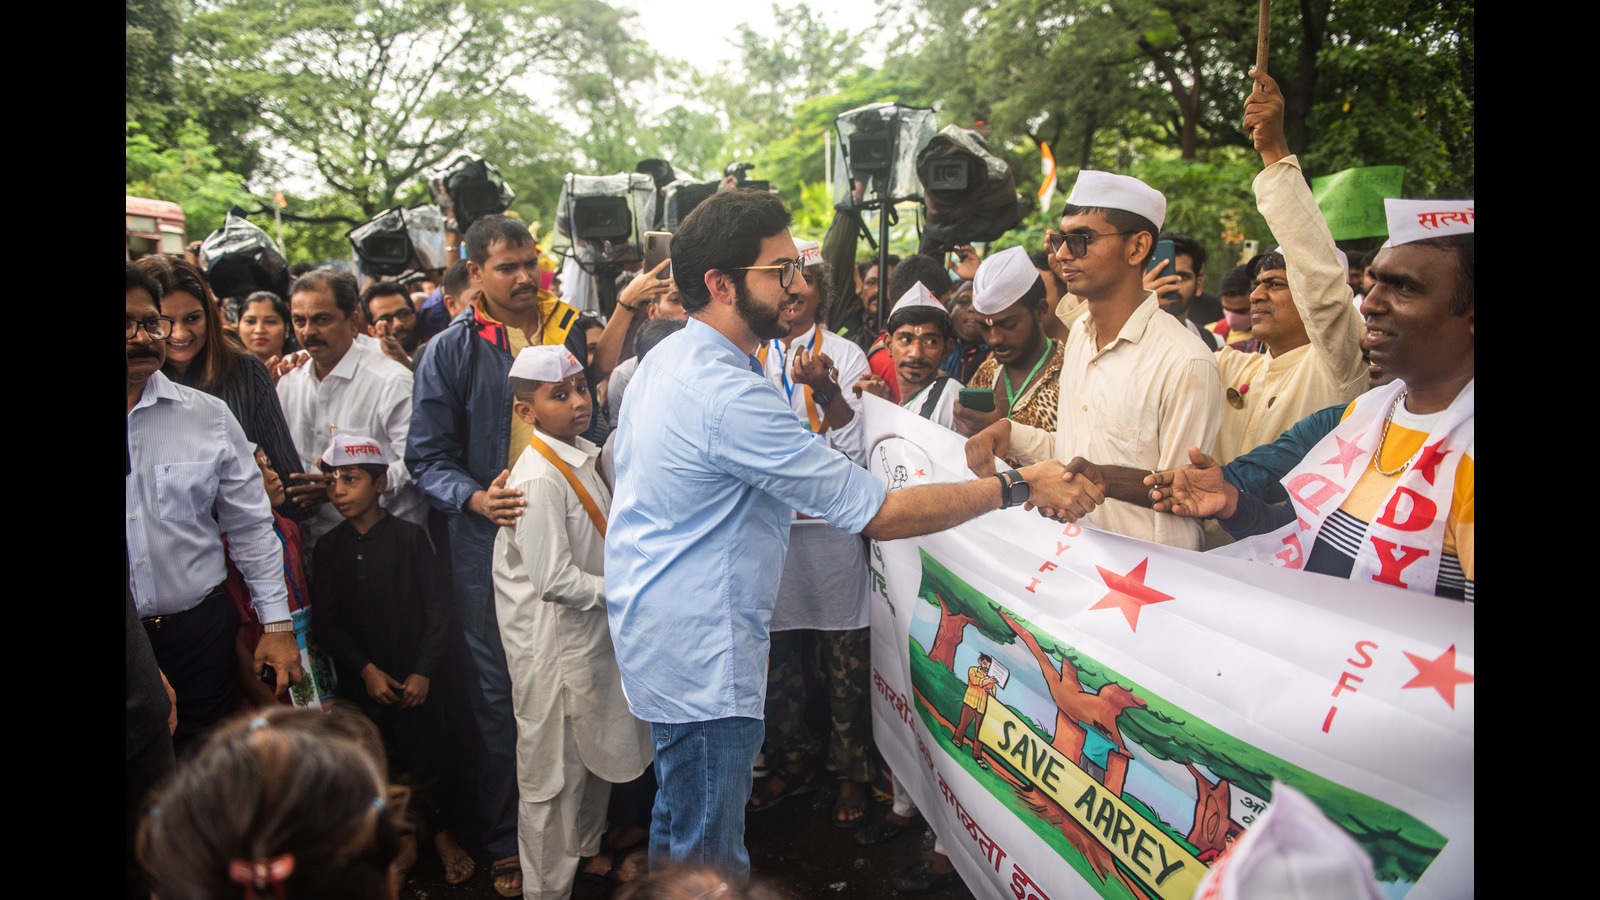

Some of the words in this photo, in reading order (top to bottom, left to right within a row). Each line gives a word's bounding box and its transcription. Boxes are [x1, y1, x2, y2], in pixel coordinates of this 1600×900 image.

[1416, 207, 1475, 231] सत्य
[1025, 521, 1082, 594] DYFI
[1321, 640, 1380, 734] SFI
[998, 720, 1066, 793] SAVE
[1074, 784, 1185, 887] AAREY
